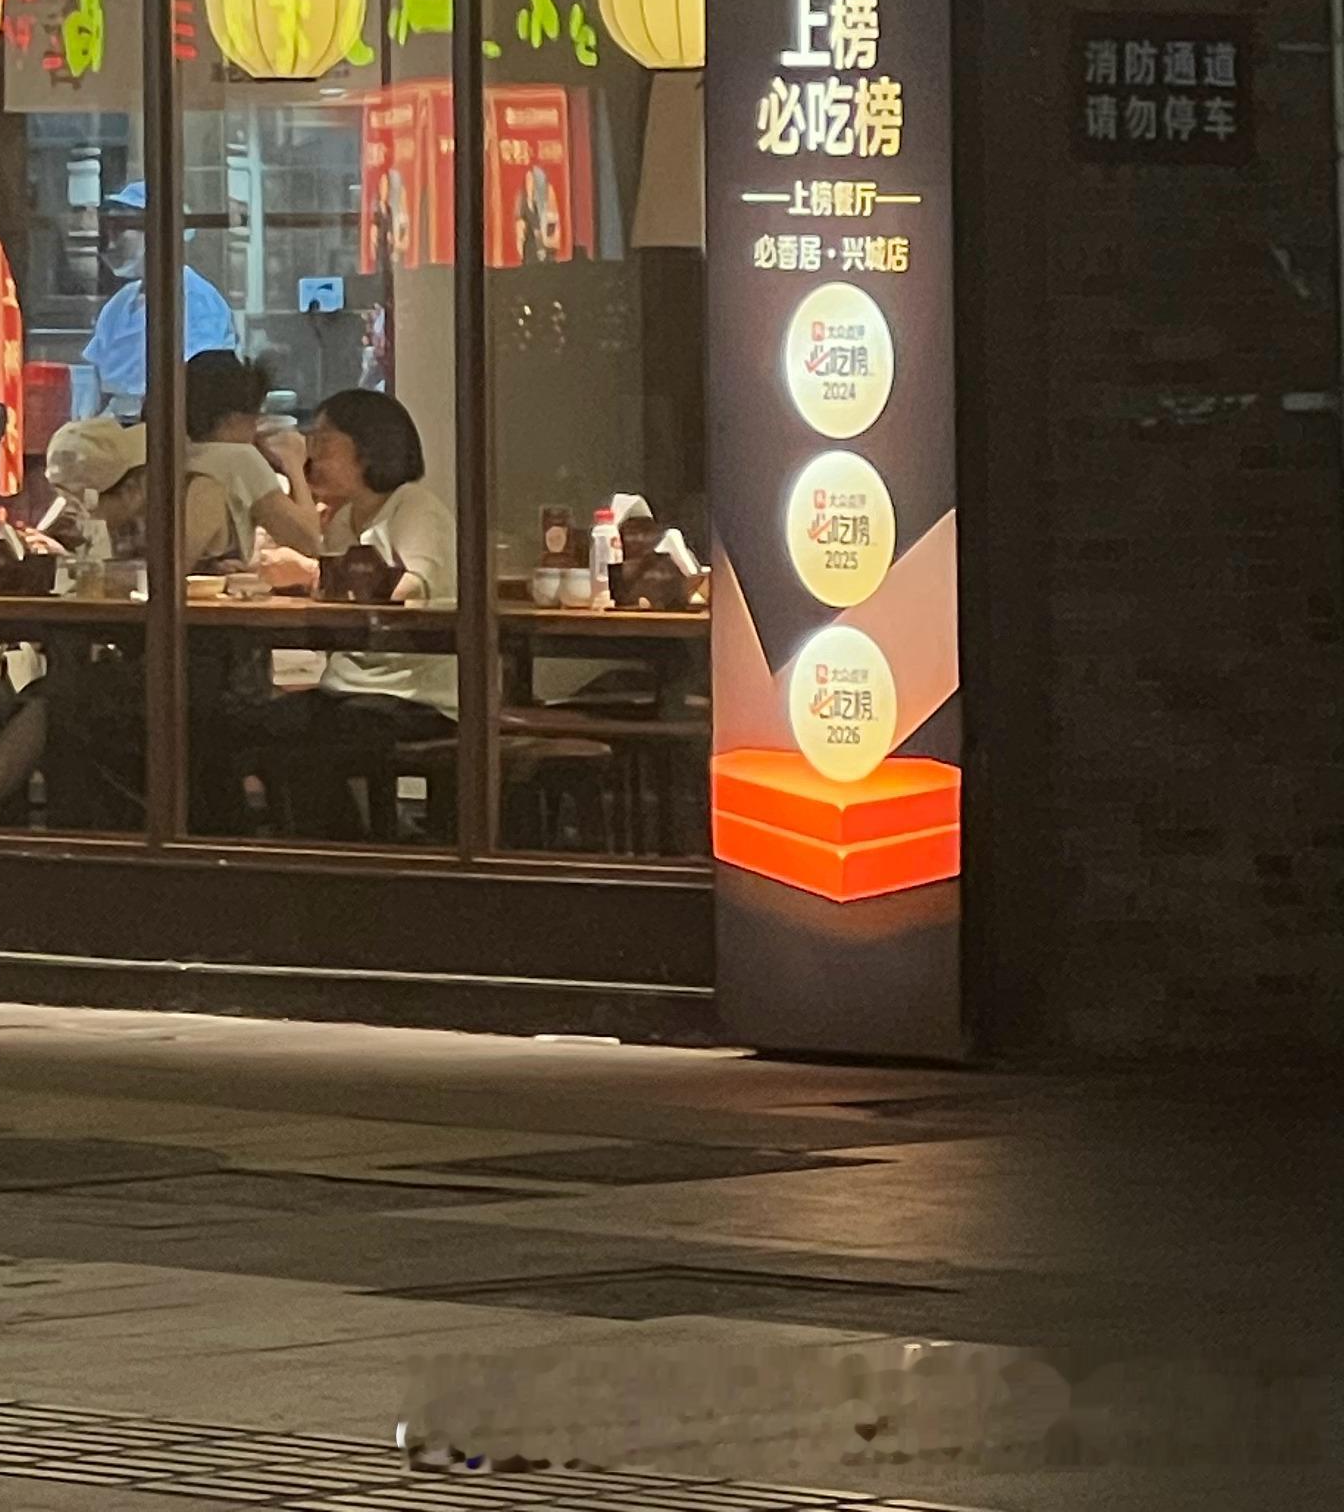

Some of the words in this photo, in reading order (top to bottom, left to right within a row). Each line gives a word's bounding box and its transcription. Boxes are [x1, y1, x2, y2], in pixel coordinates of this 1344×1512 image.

[1085, 39, 1237, 87] 消防通道
[757, 76, 903, 158] 必吃榜
[1085, 94, 1237, 142] 请勿停车
[823, 382, 857, 401] 2024
[824, 550, 859, 570] 2025
[827, 725, 861, 745] 2026
